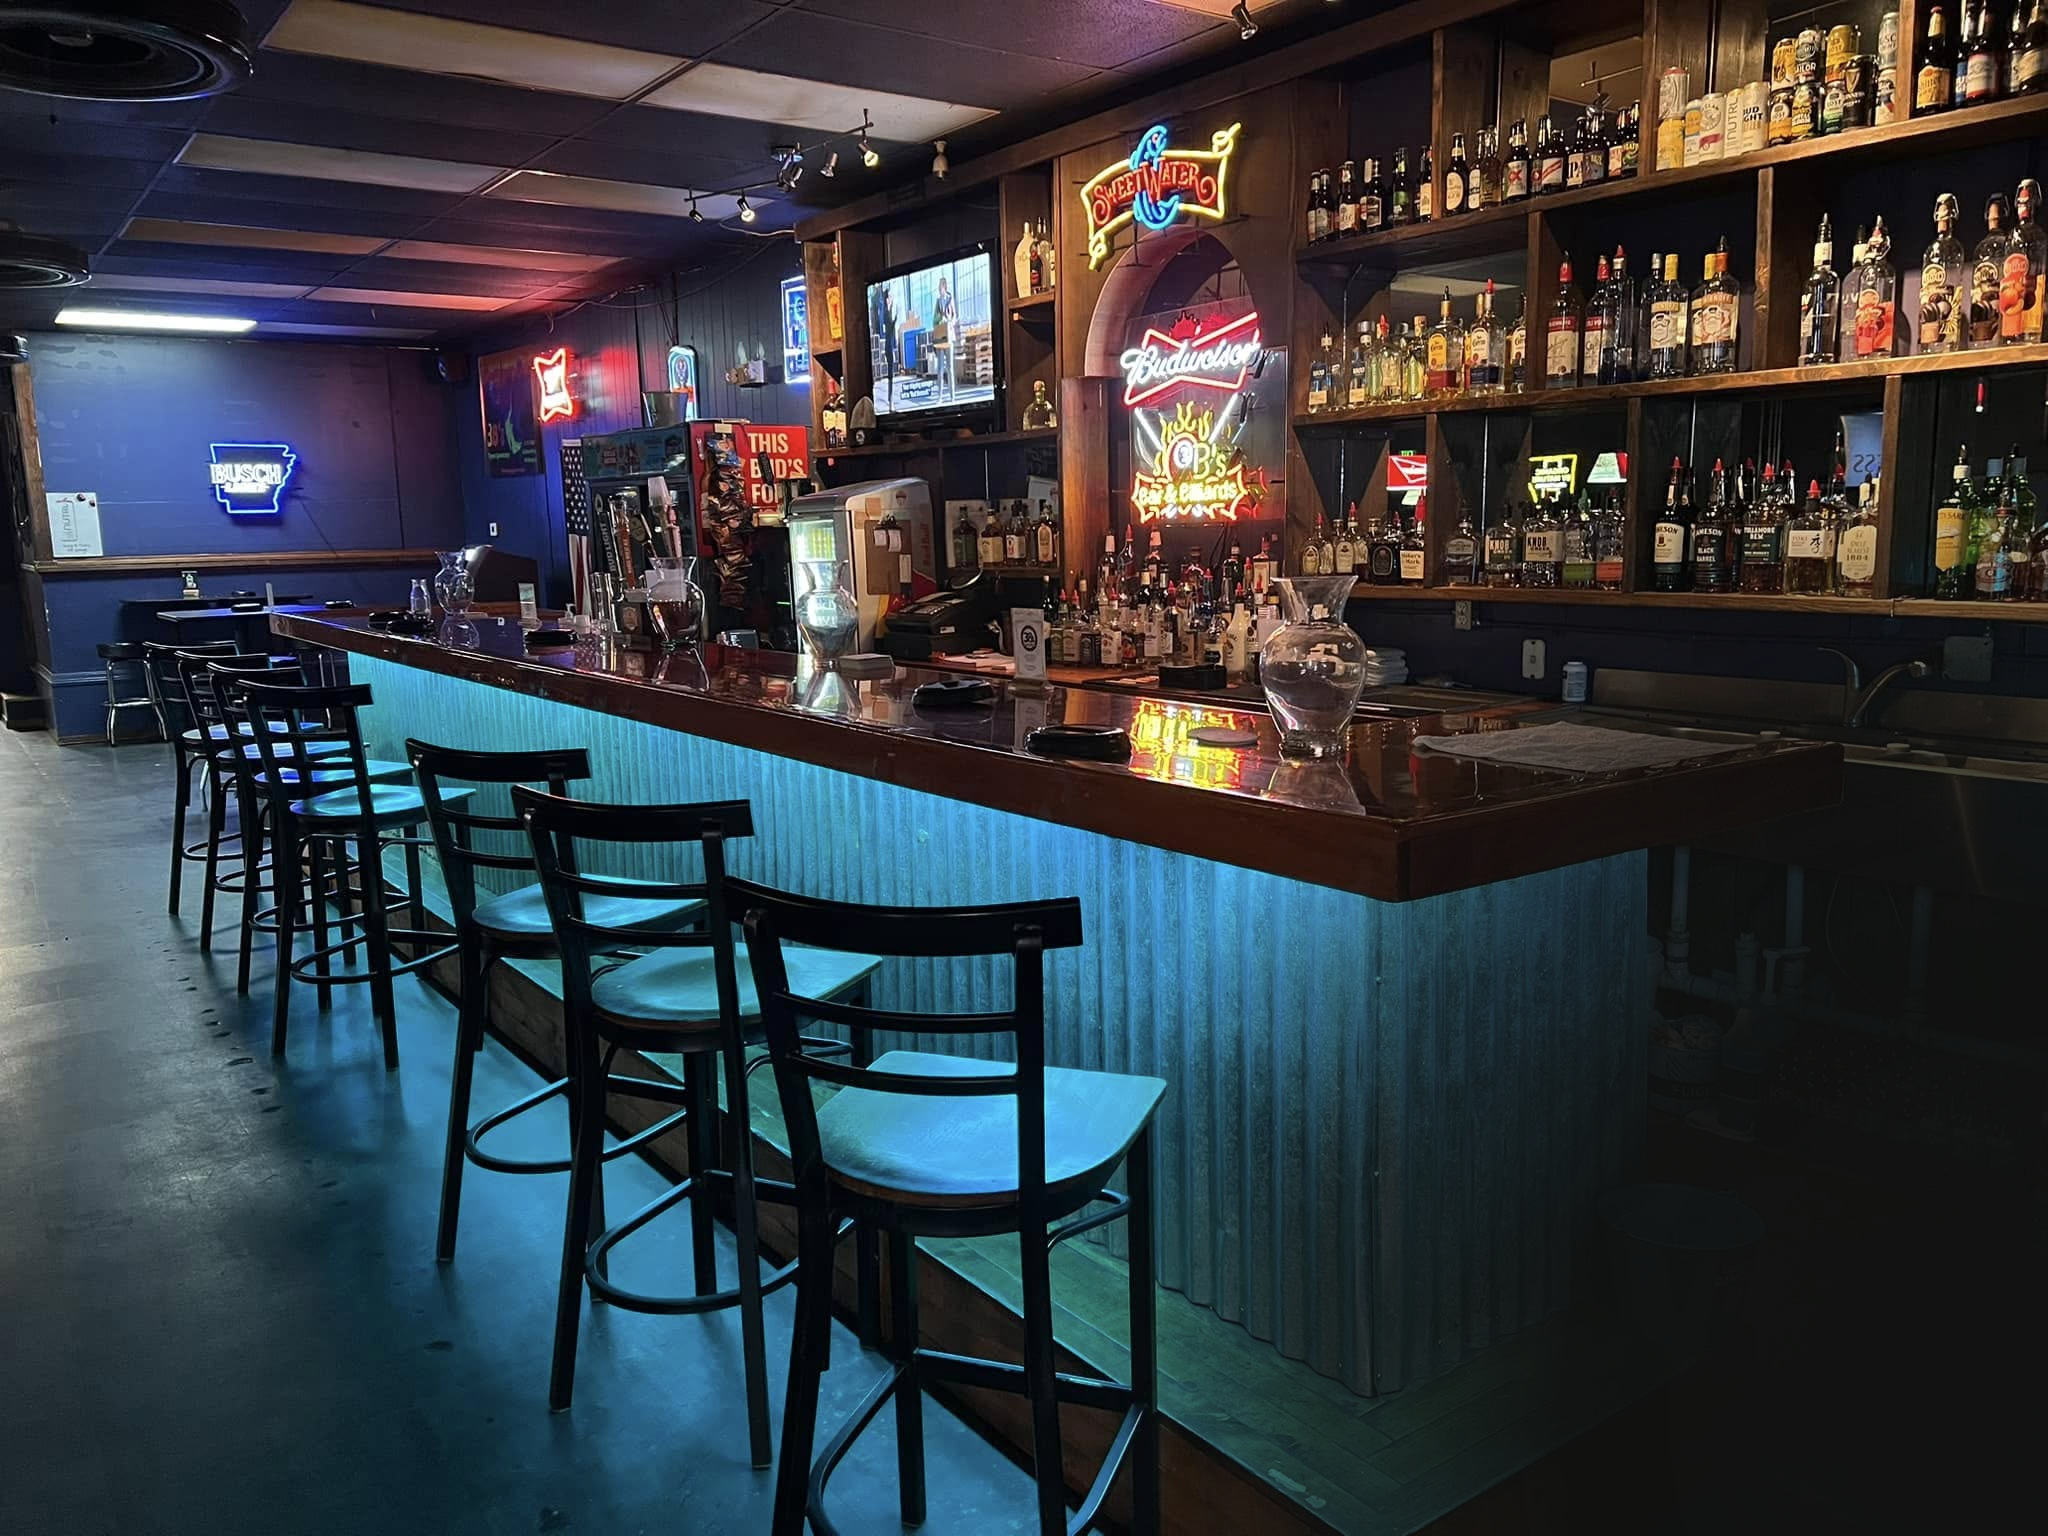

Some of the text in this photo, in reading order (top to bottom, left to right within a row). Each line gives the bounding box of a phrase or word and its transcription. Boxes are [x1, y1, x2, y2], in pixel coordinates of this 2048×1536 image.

[1120, 337, 1261, 386] Budweiser
[748, 432, 790, 454] THIS
[209, 463, 282, 485] BUSCH
[751, 483, 780, 504] FO
